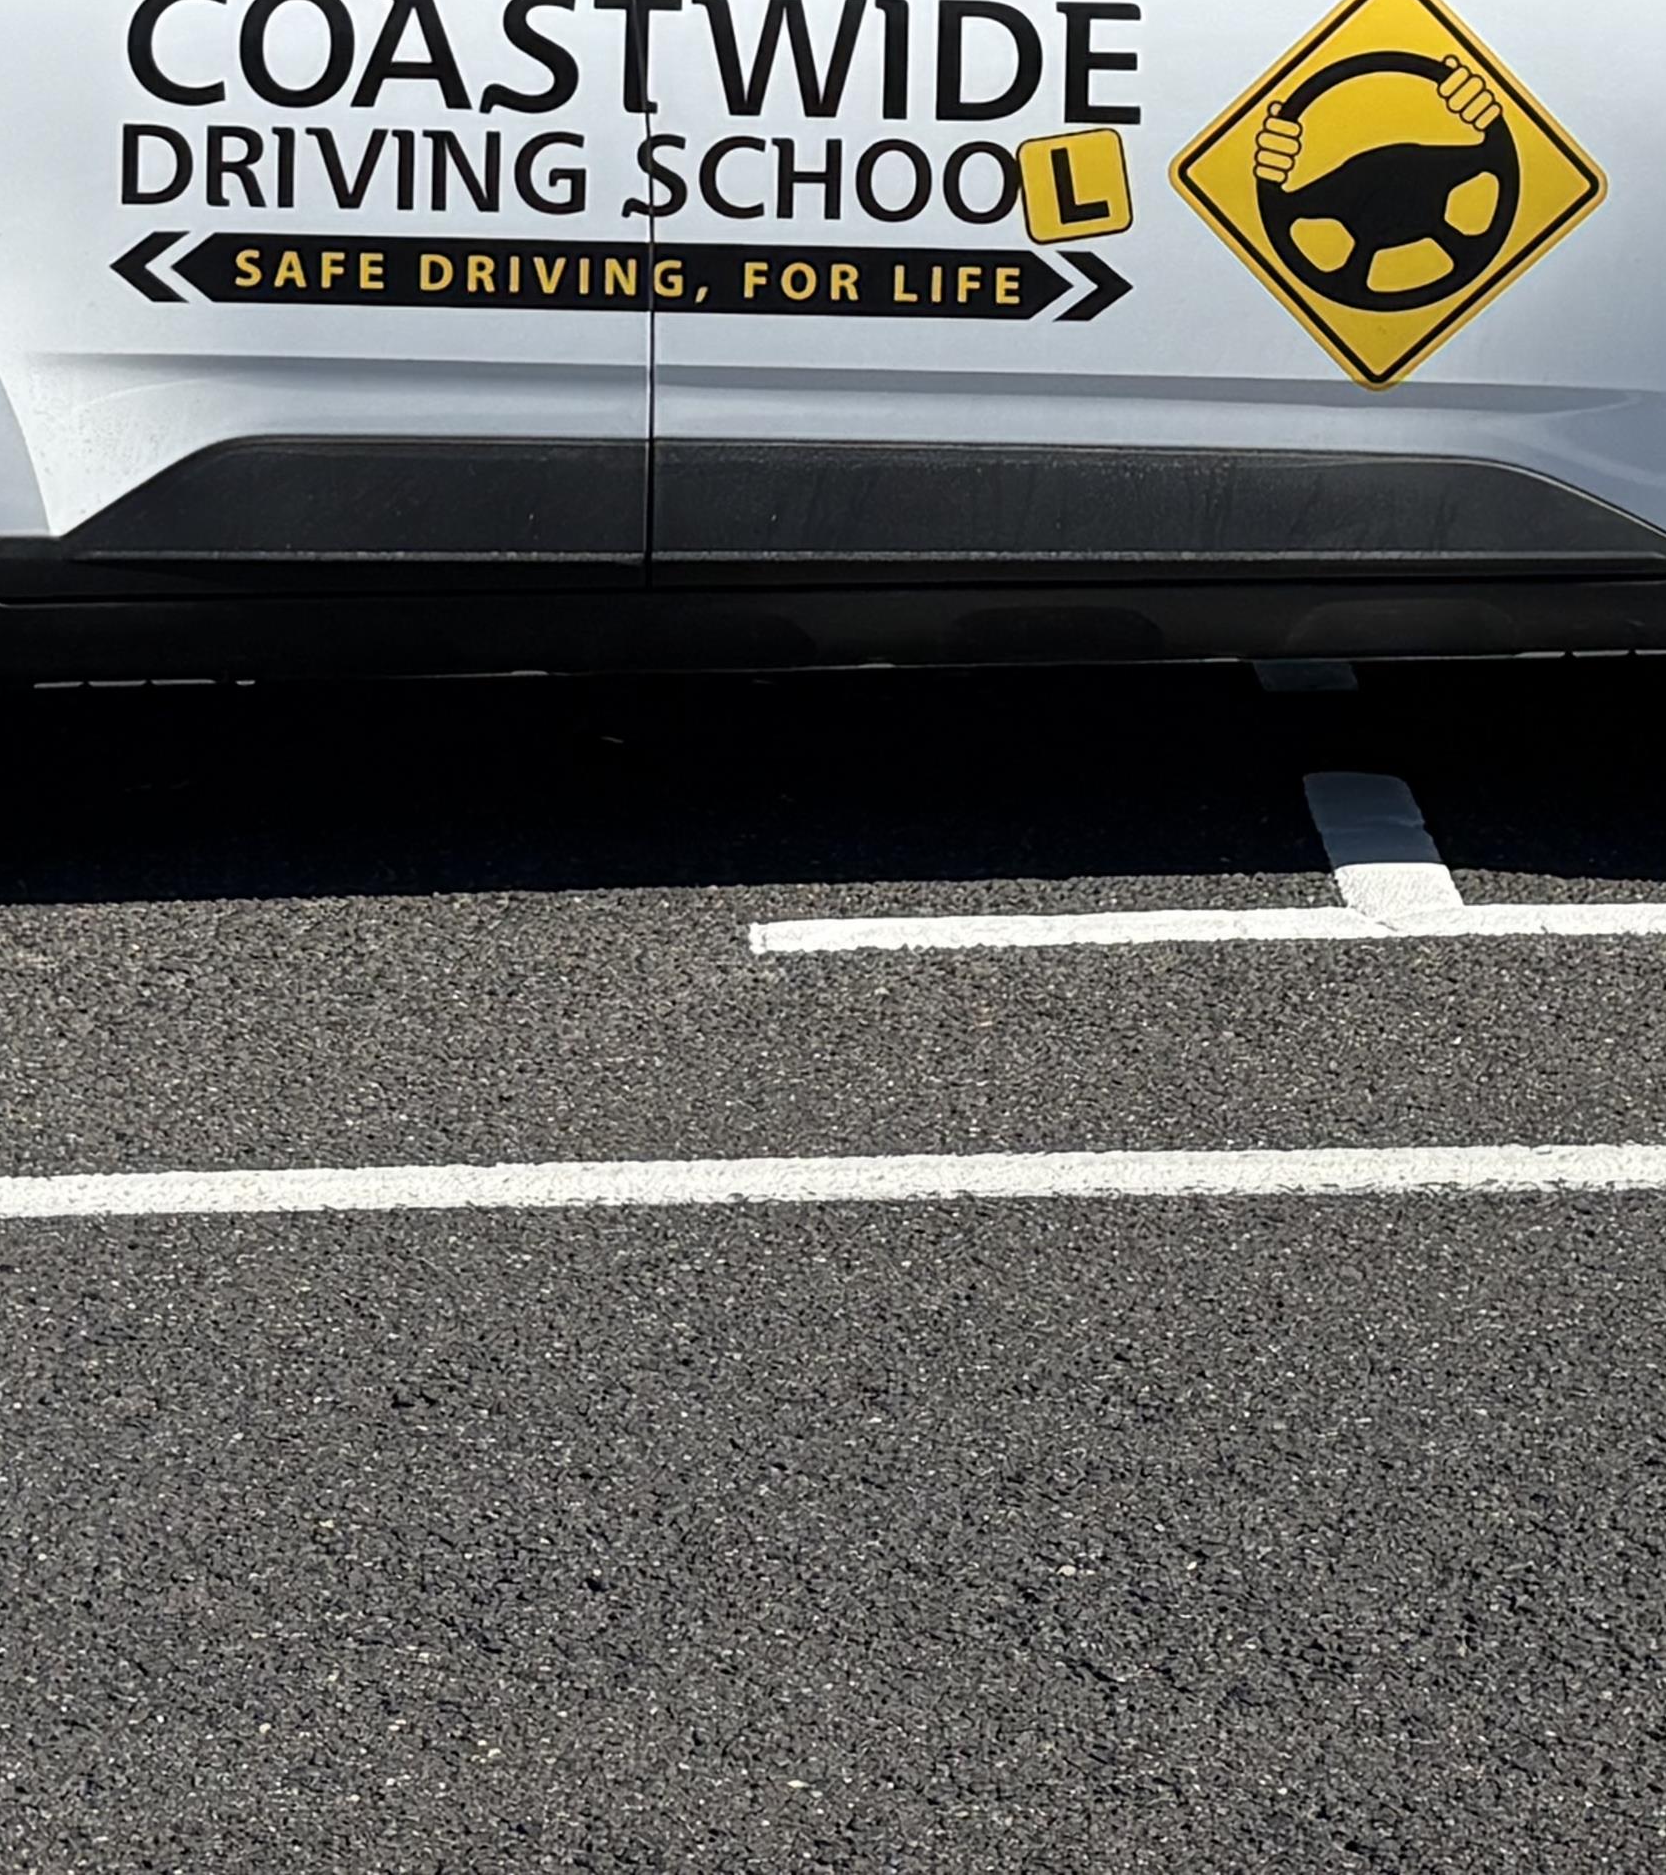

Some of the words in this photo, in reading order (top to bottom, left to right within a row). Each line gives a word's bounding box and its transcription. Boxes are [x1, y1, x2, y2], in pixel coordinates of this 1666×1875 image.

[121, 122, 587, 216] DRIVING
[621, 133, 1110, 225] SCHOOL
[234, 248, 385, 290] SAFE
[419, 253, 709, 304] DRIVING,
[743, 261, 860, 302] FOR
[893, 264, 1022, 306] LIFE
